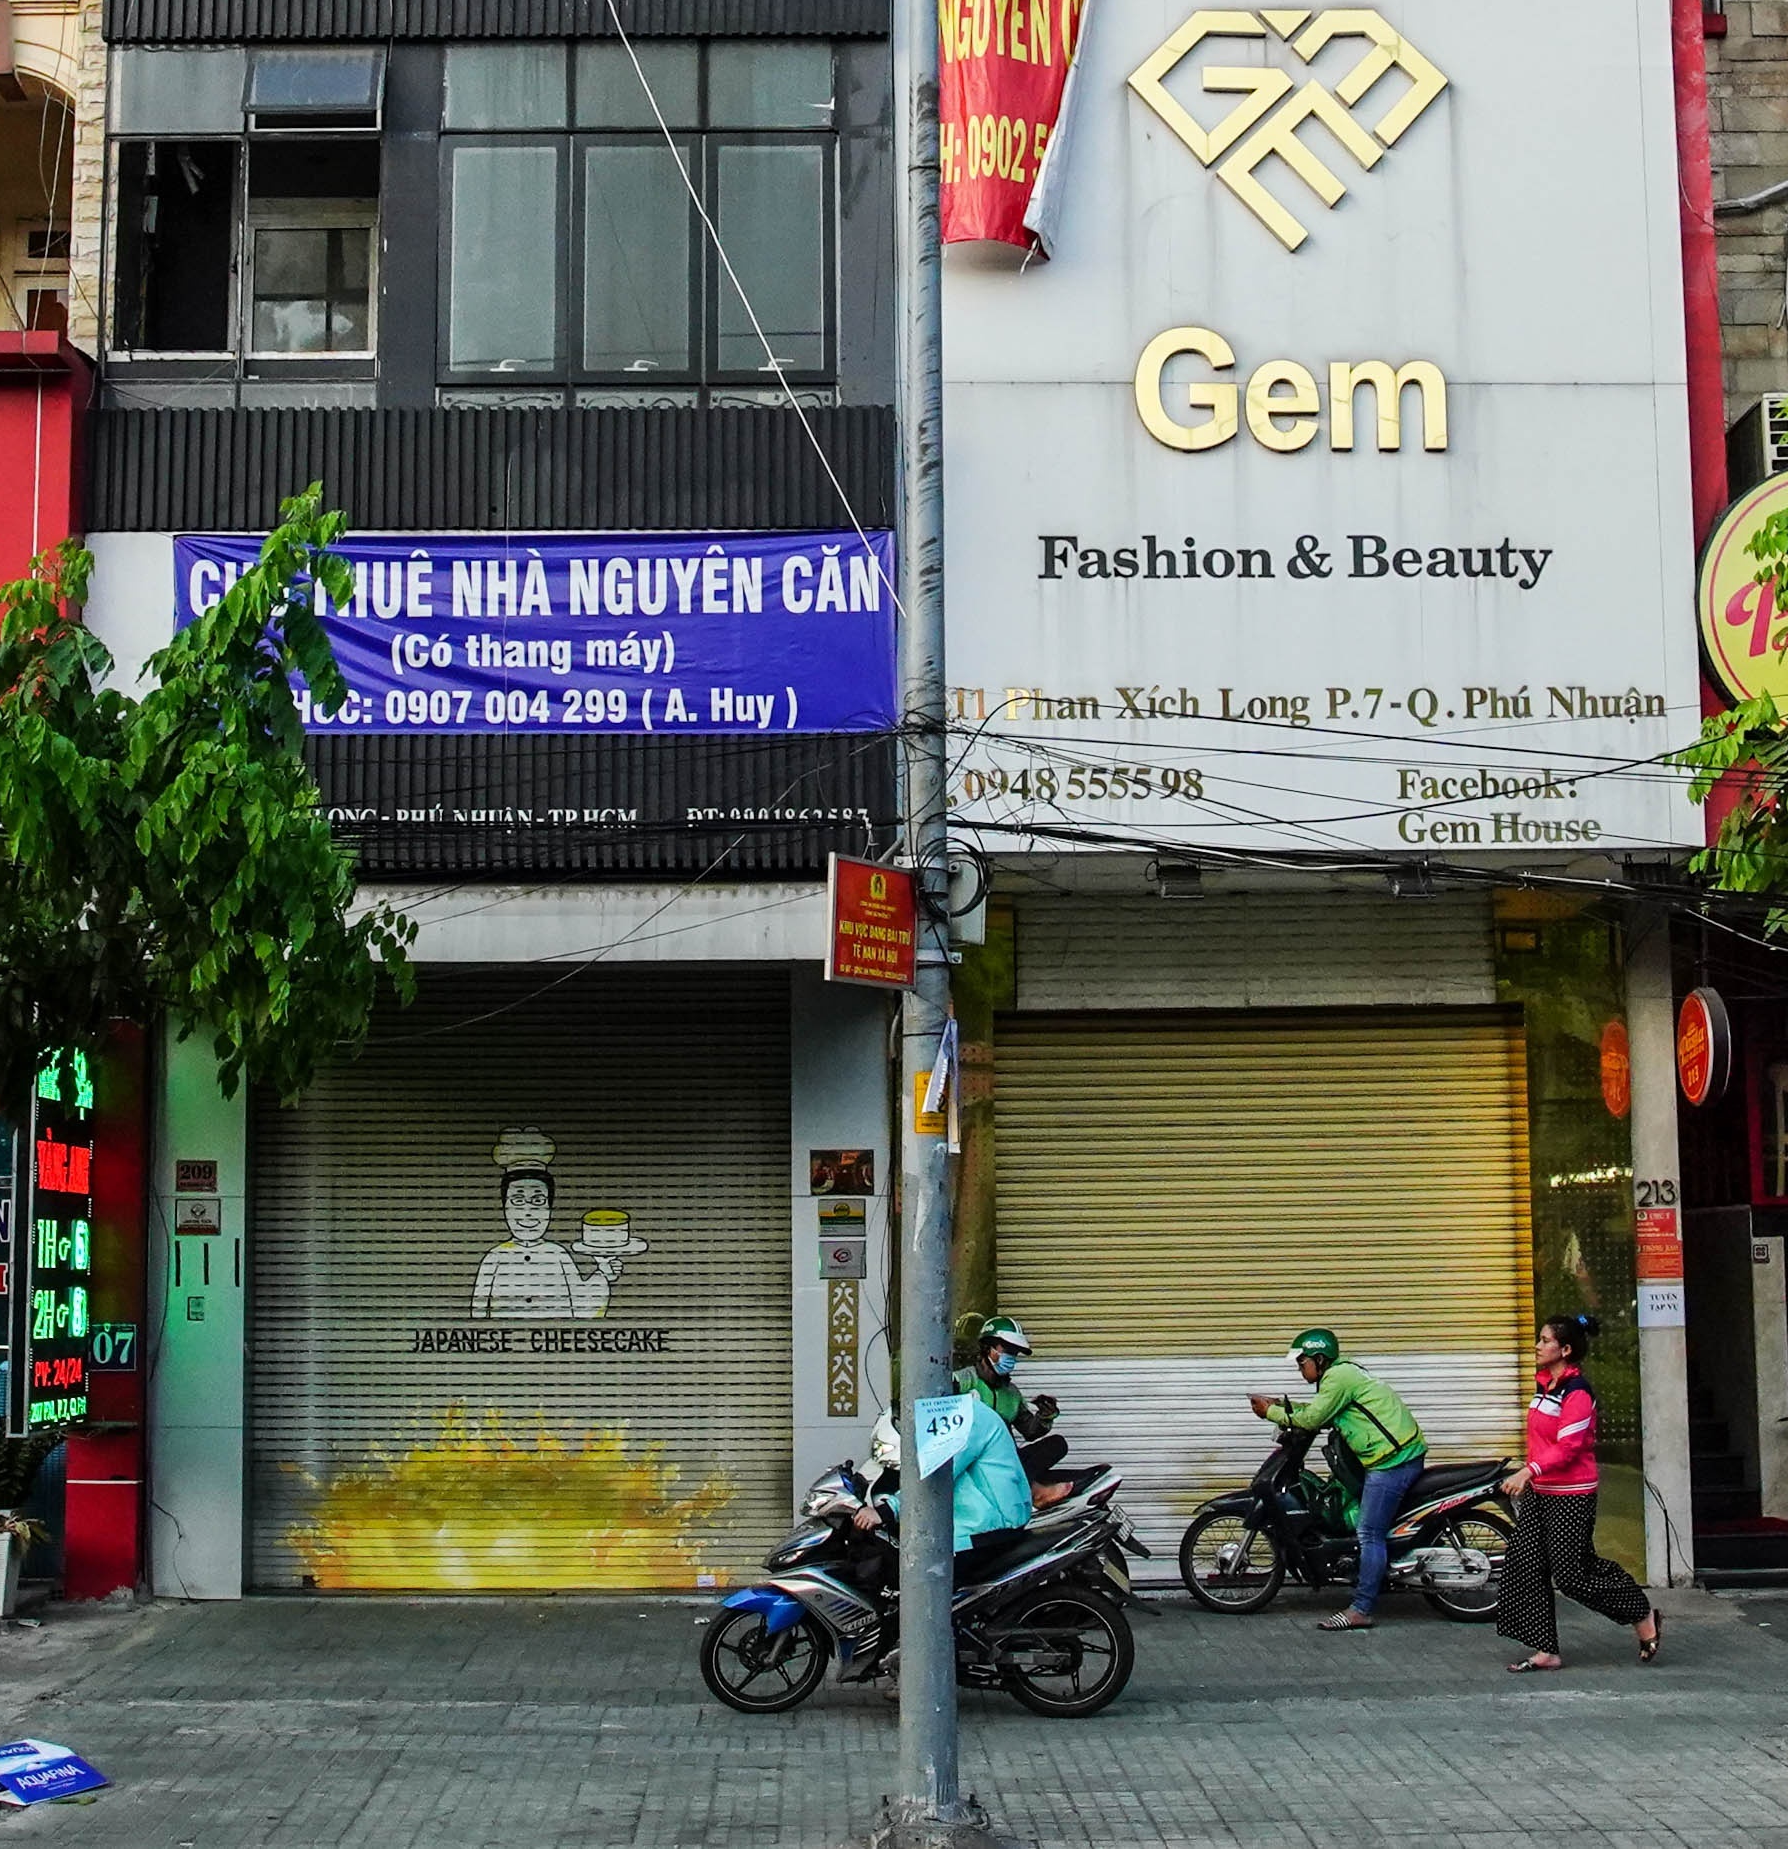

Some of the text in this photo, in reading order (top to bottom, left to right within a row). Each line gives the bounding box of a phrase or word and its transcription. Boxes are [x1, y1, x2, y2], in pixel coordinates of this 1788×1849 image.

[940, 122, 961, 185] H:
[967, 114, 1027, 183] 0902
[1135, 326, 1447, 453] Gem
[1038, 534, 1553, 590] Fashion & Beauty
[452, 549, 553, 617] NHÀ
[570, 544, 763, 616] NGUYÊN
[782, 544, 880, 614] CĂN
[392, 631, 675, 675] (Có thang máy)
[385, 689, 472, 724] 0907
[484, 689, 550, 724] 004
[562, 689, 628, 723] 299
[710, 687, 774, 729] Huy
[1004, 688, 1100, 721] Phan
[1115, 684, 1200, 719] Xích
[1218, 687, 1310, 727] Long
[1547, 685, 1667, 724] Nhuận
[964, 767, 1057, 801] 0948
[1396, 768, 1578, 800] Facebook:
[1398, 811, 1602, 844] Gem House
[180, 1164, 213, 1180] 209
[1636, 1179, 1676, 1208] 213
[92, 1331, 134, 1365] 07
[412, 1329, 672, 1352] JAPANESE CHEESECAKE
[926, 1414, 965, 1438] 439
[15, 1763, 87, 1790] AQUAFINA
